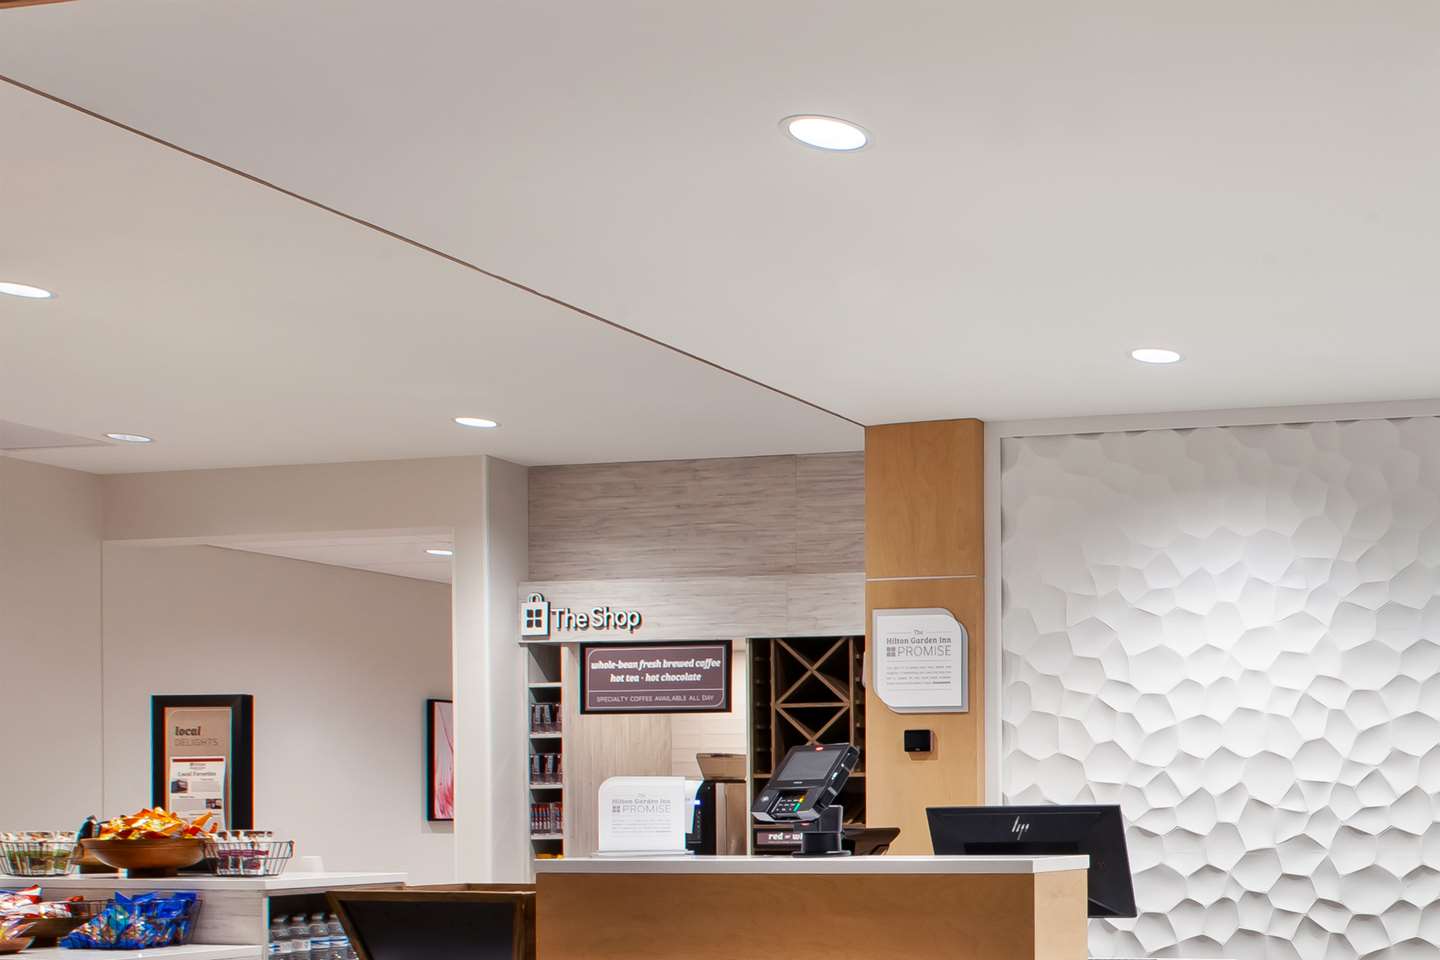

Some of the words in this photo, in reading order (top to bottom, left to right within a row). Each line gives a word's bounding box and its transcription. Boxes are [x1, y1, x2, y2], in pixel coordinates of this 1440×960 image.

[551, 607, 589, 630] The
[592, 606, 642, 633] Shop
[911, 637, 937, 645] Garden
[897, 645, 952, 657] PROMISE
[591, 660, 639, 670] whole-bean
[638, 659, 662, 671] fresh
[663, 658, 694, 668] brewed
[695, 658, 721, 670] coffee
[610, 674, 625, 683] hot
[626, 674, 640, 683] tea
[645, 673, 660, 682] hot
[661, 672, 702, 682] chocolate
[175, 726, 201, 736] local
[1011, 815, 1030, 841] hp
[768, 832, 784, 840] red
